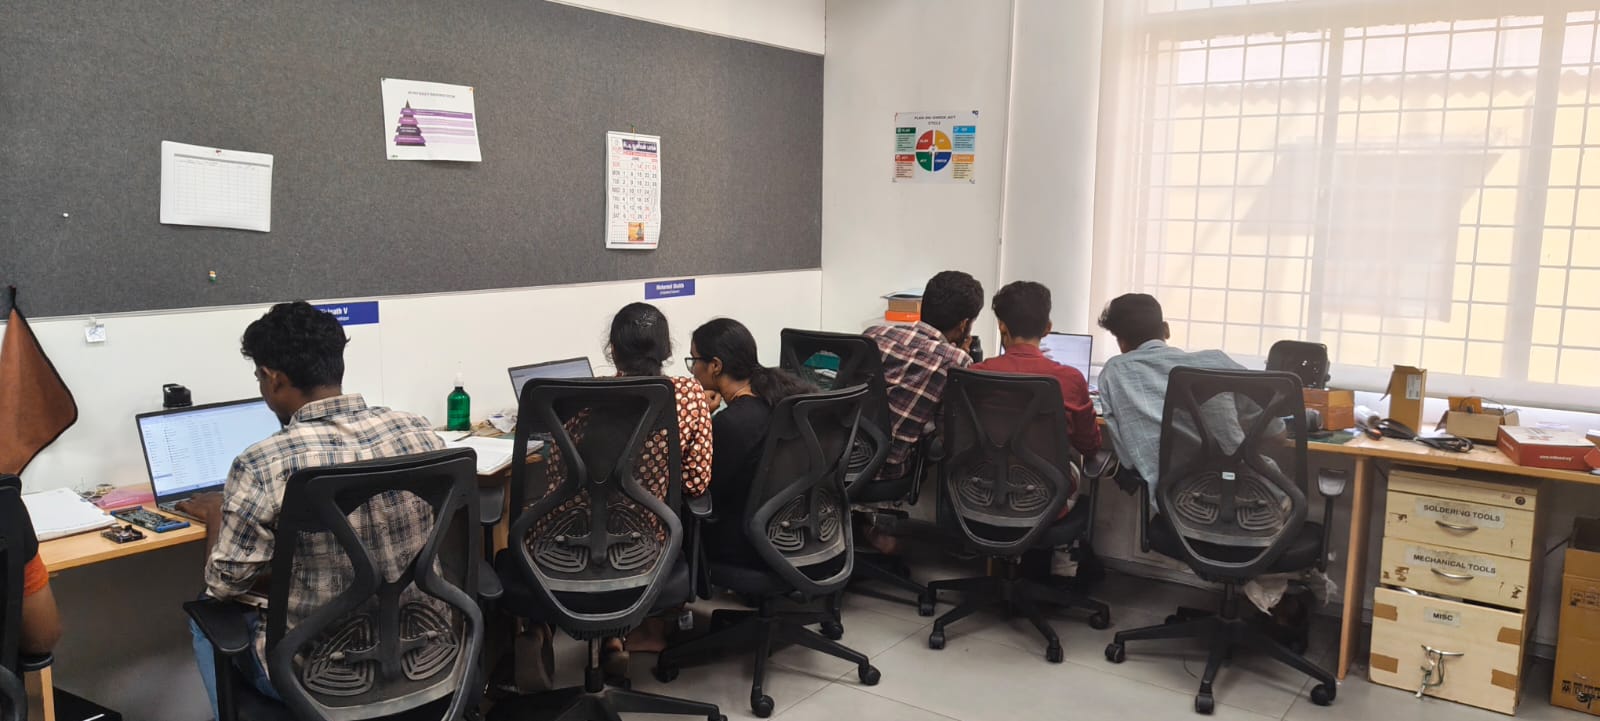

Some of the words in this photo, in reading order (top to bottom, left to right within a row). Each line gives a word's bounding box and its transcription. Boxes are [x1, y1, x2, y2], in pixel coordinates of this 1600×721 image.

[1424, 504, 1470, 517] SOLDERING
[1472, 512, 1500, 522] TOOLS
[1413, 554, 1466, 569] MECHANICAL
[1467, 564, 1496, 574] TOOLS
[1433, 612, 1453, 621] MISC
